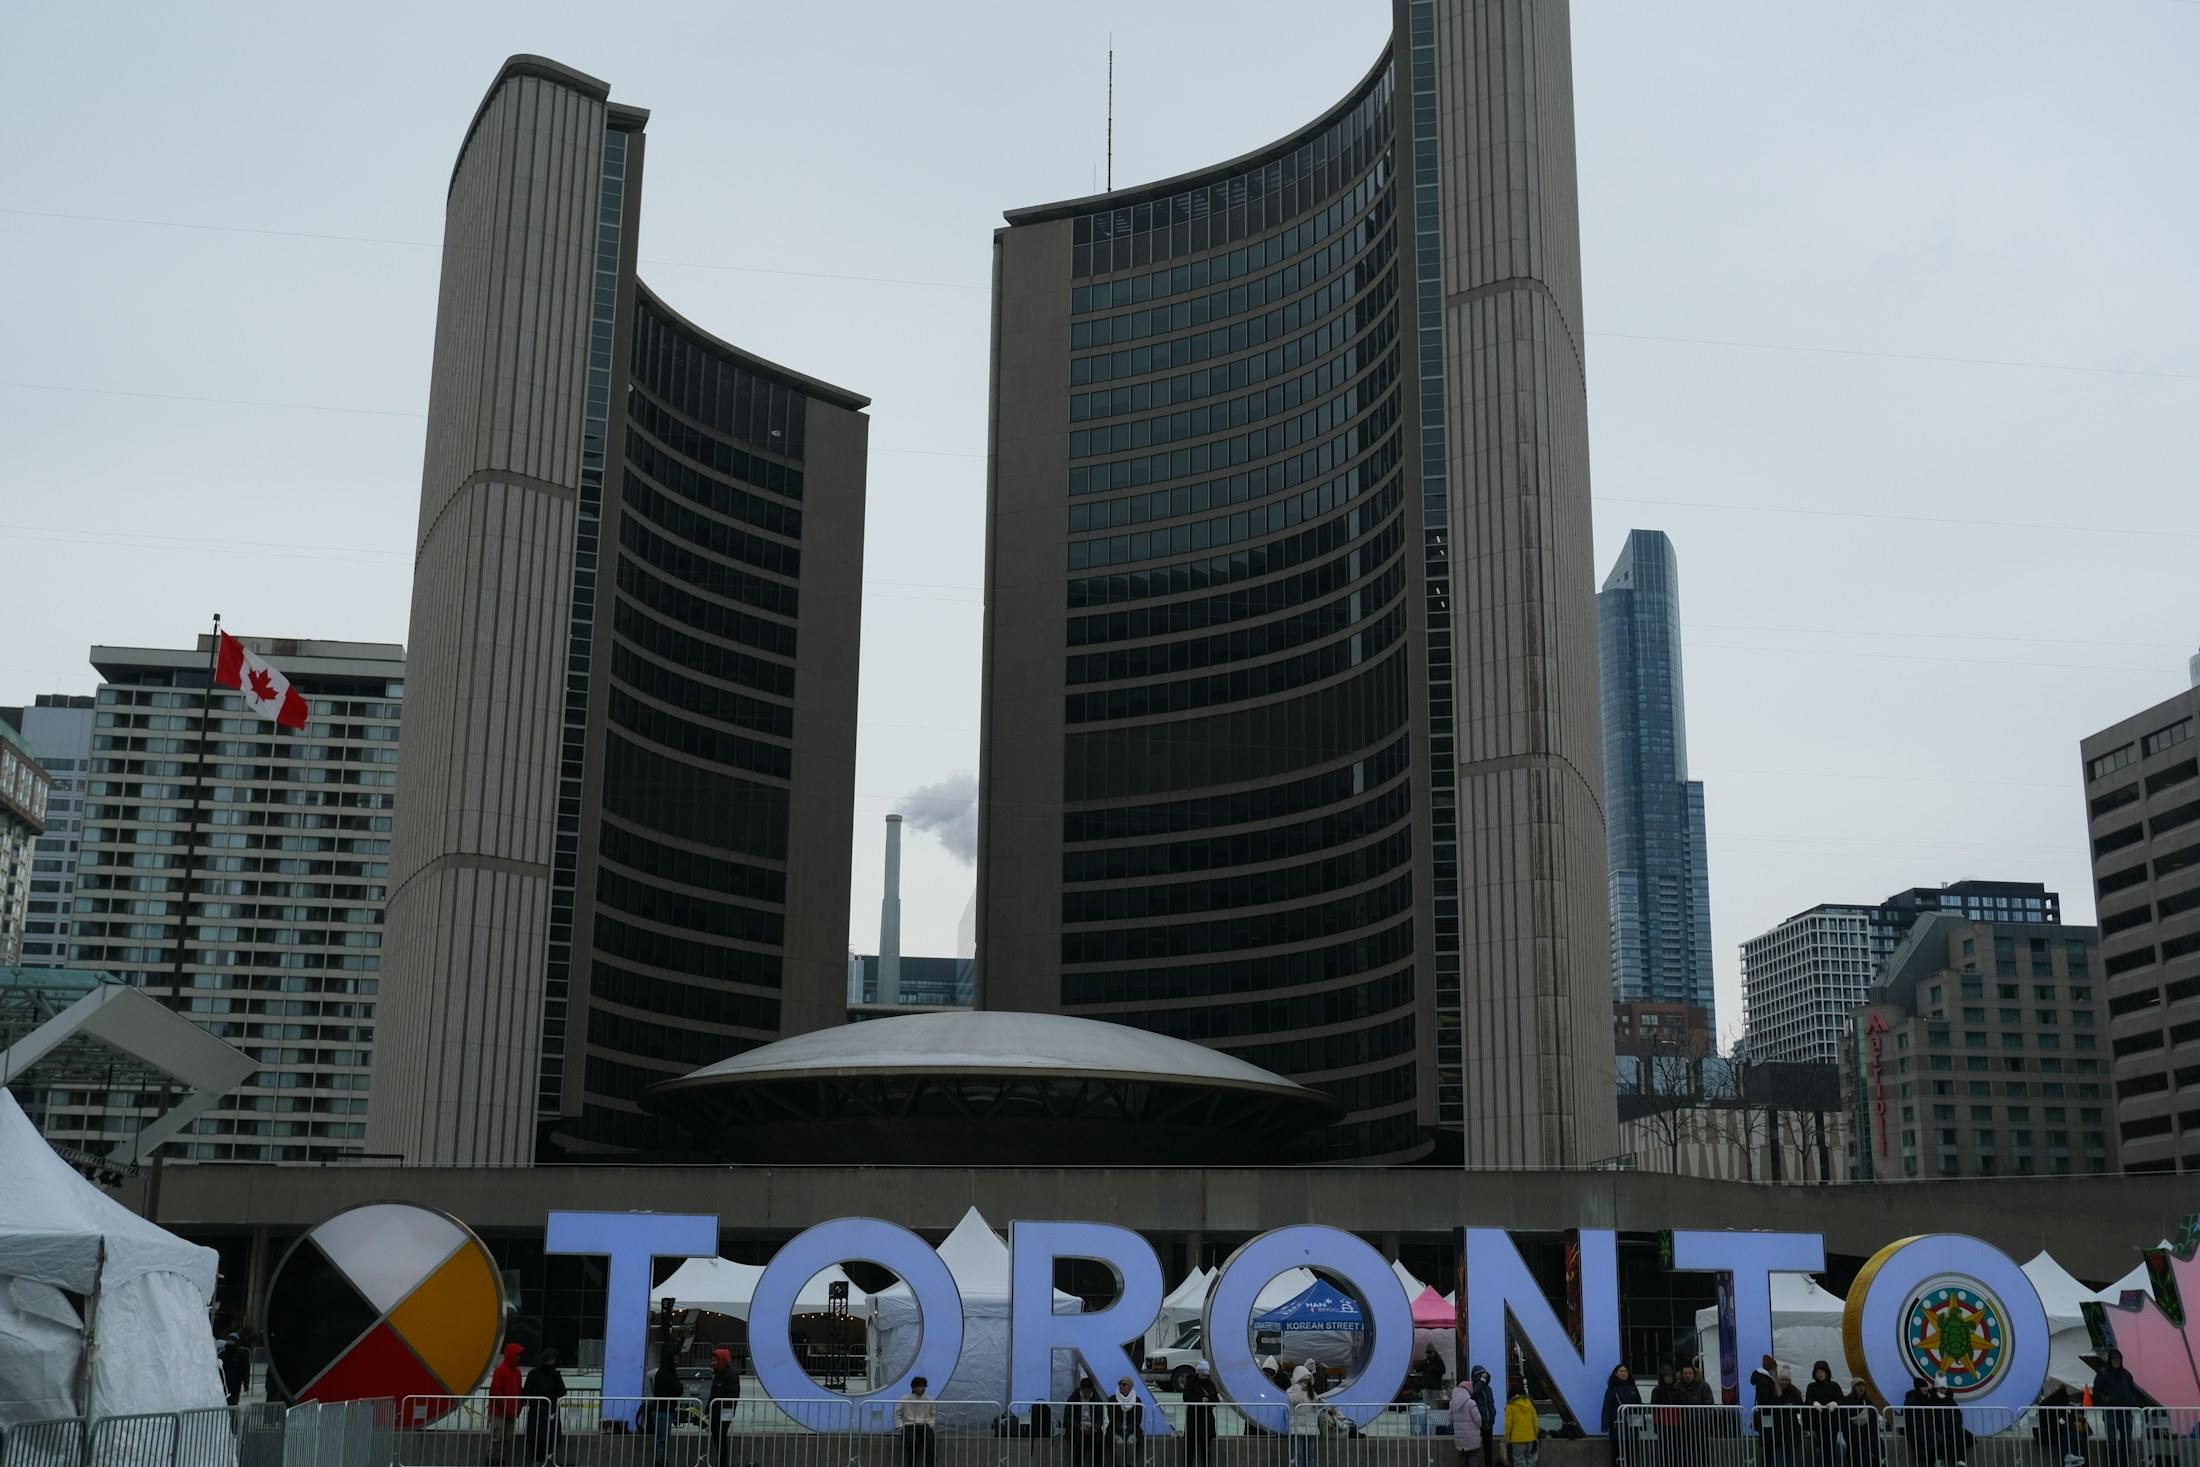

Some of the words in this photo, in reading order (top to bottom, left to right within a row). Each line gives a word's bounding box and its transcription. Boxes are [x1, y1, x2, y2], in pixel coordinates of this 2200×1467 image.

[543, 1210, 2051, 1438] TORONTO
[1286, 1321, 1324, 1330] KOREAN
[1325, 1321, 1360, 1330] STREET
